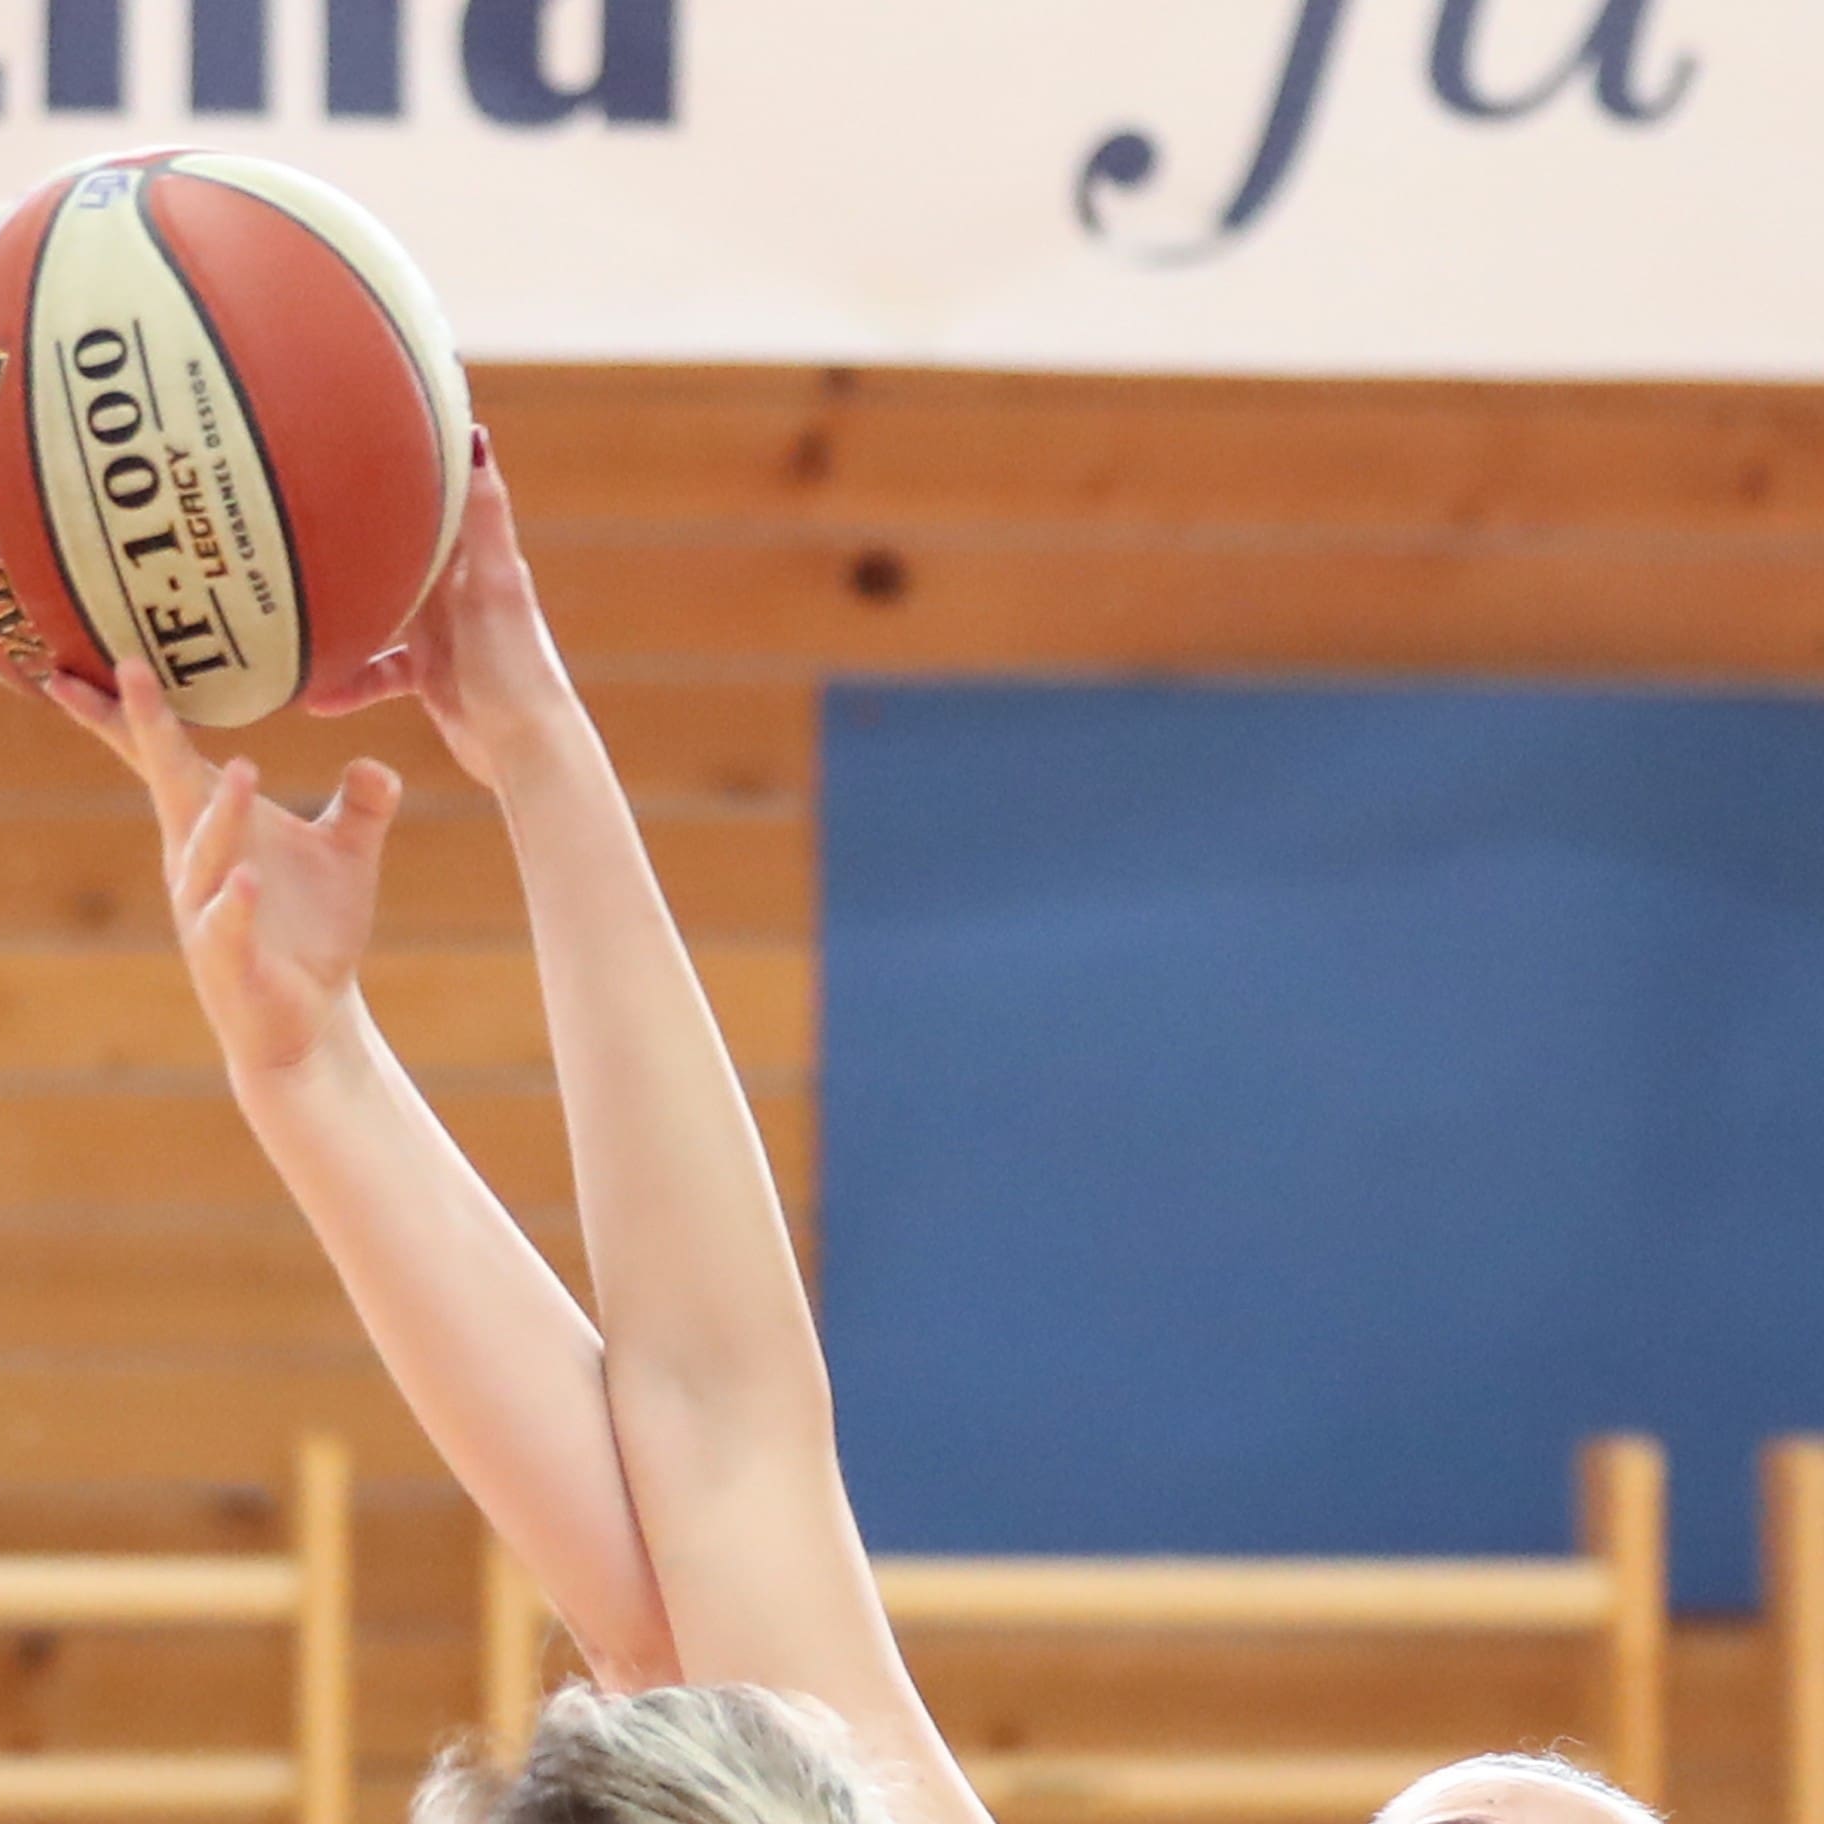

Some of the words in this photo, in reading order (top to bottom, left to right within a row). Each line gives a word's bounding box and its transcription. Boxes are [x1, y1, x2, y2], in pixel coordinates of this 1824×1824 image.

[186, 359, 221, 448] DESIGN
[73, 329, 230, 688] TF-1000
[164, 442, 229, 583] LEGACY
[211, 460, 256, 560] CHANNEL
[246, 569, 276, 616] DEEP
